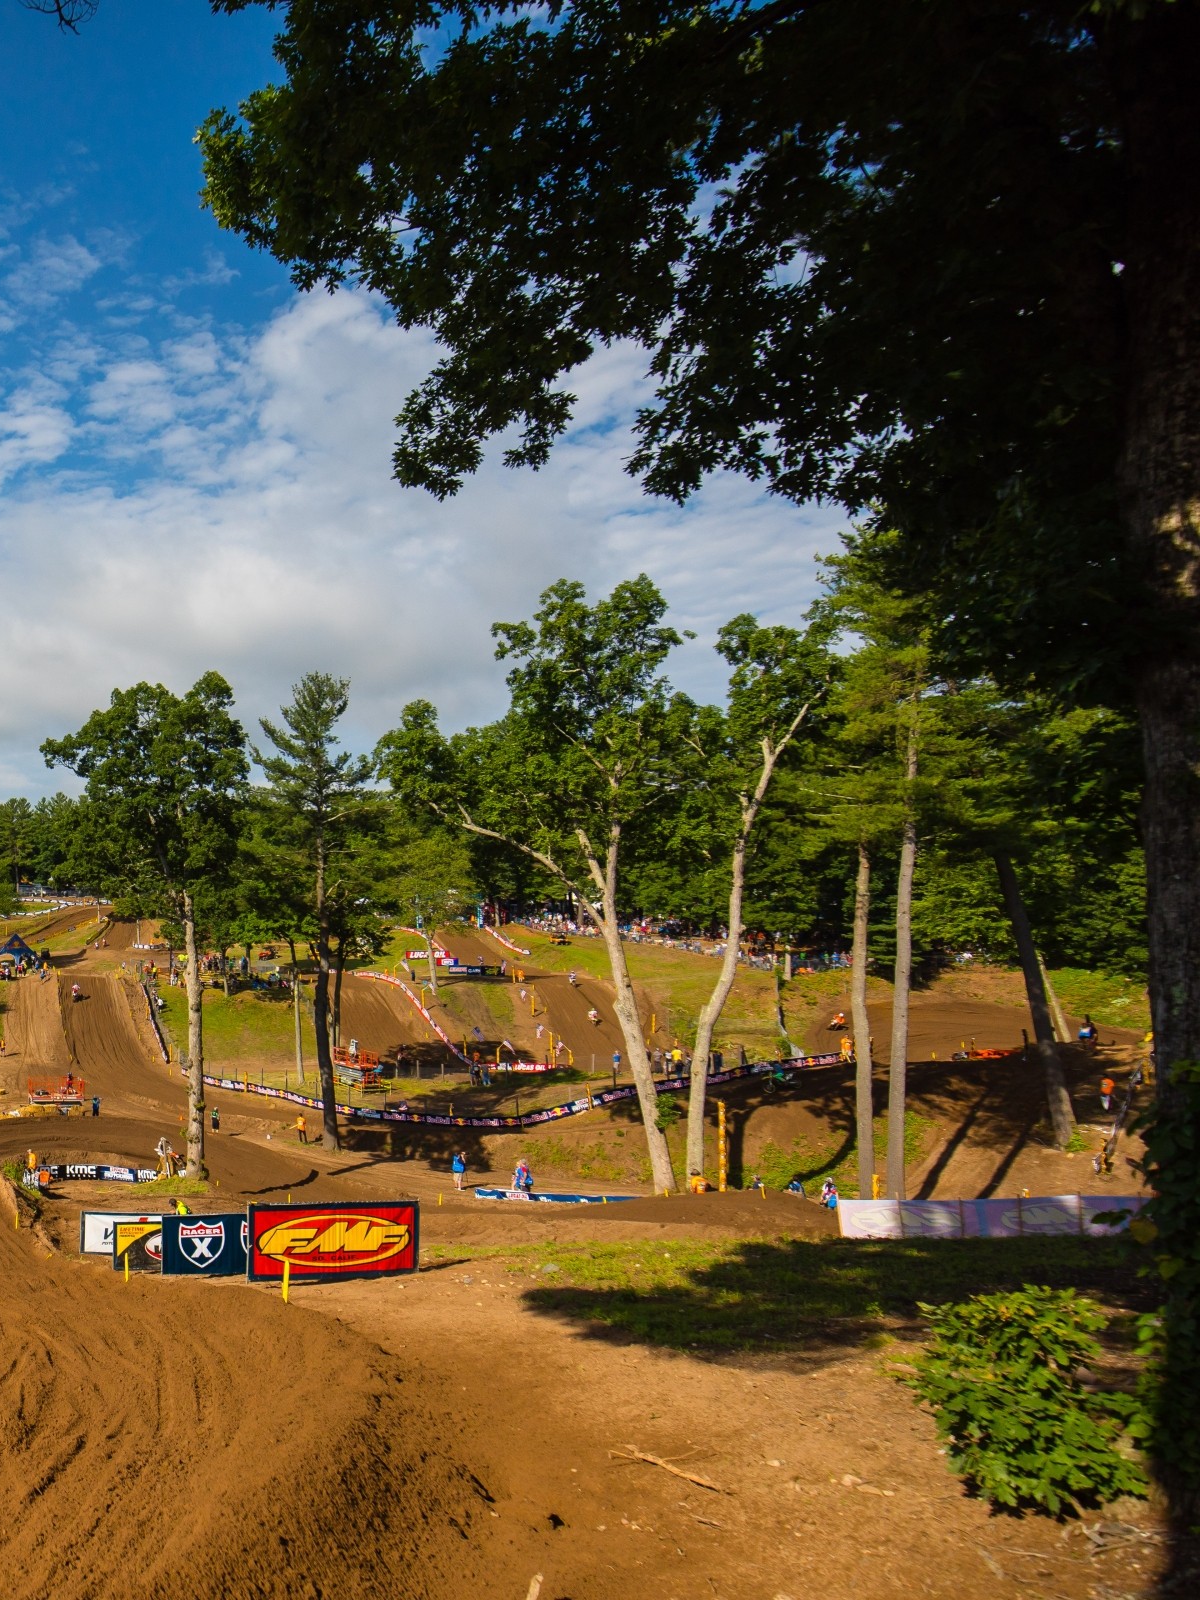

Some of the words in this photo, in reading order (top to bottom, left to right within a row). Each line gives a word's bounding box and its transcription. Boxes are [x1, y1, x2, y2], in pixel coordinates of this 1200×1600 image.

[66, 1165, 97, 1175] KMC
[138, 1169, 157, 1179] KMC
[260, 1220, 408, 1255] FMF
[191, 1238, 213, 1258] X
